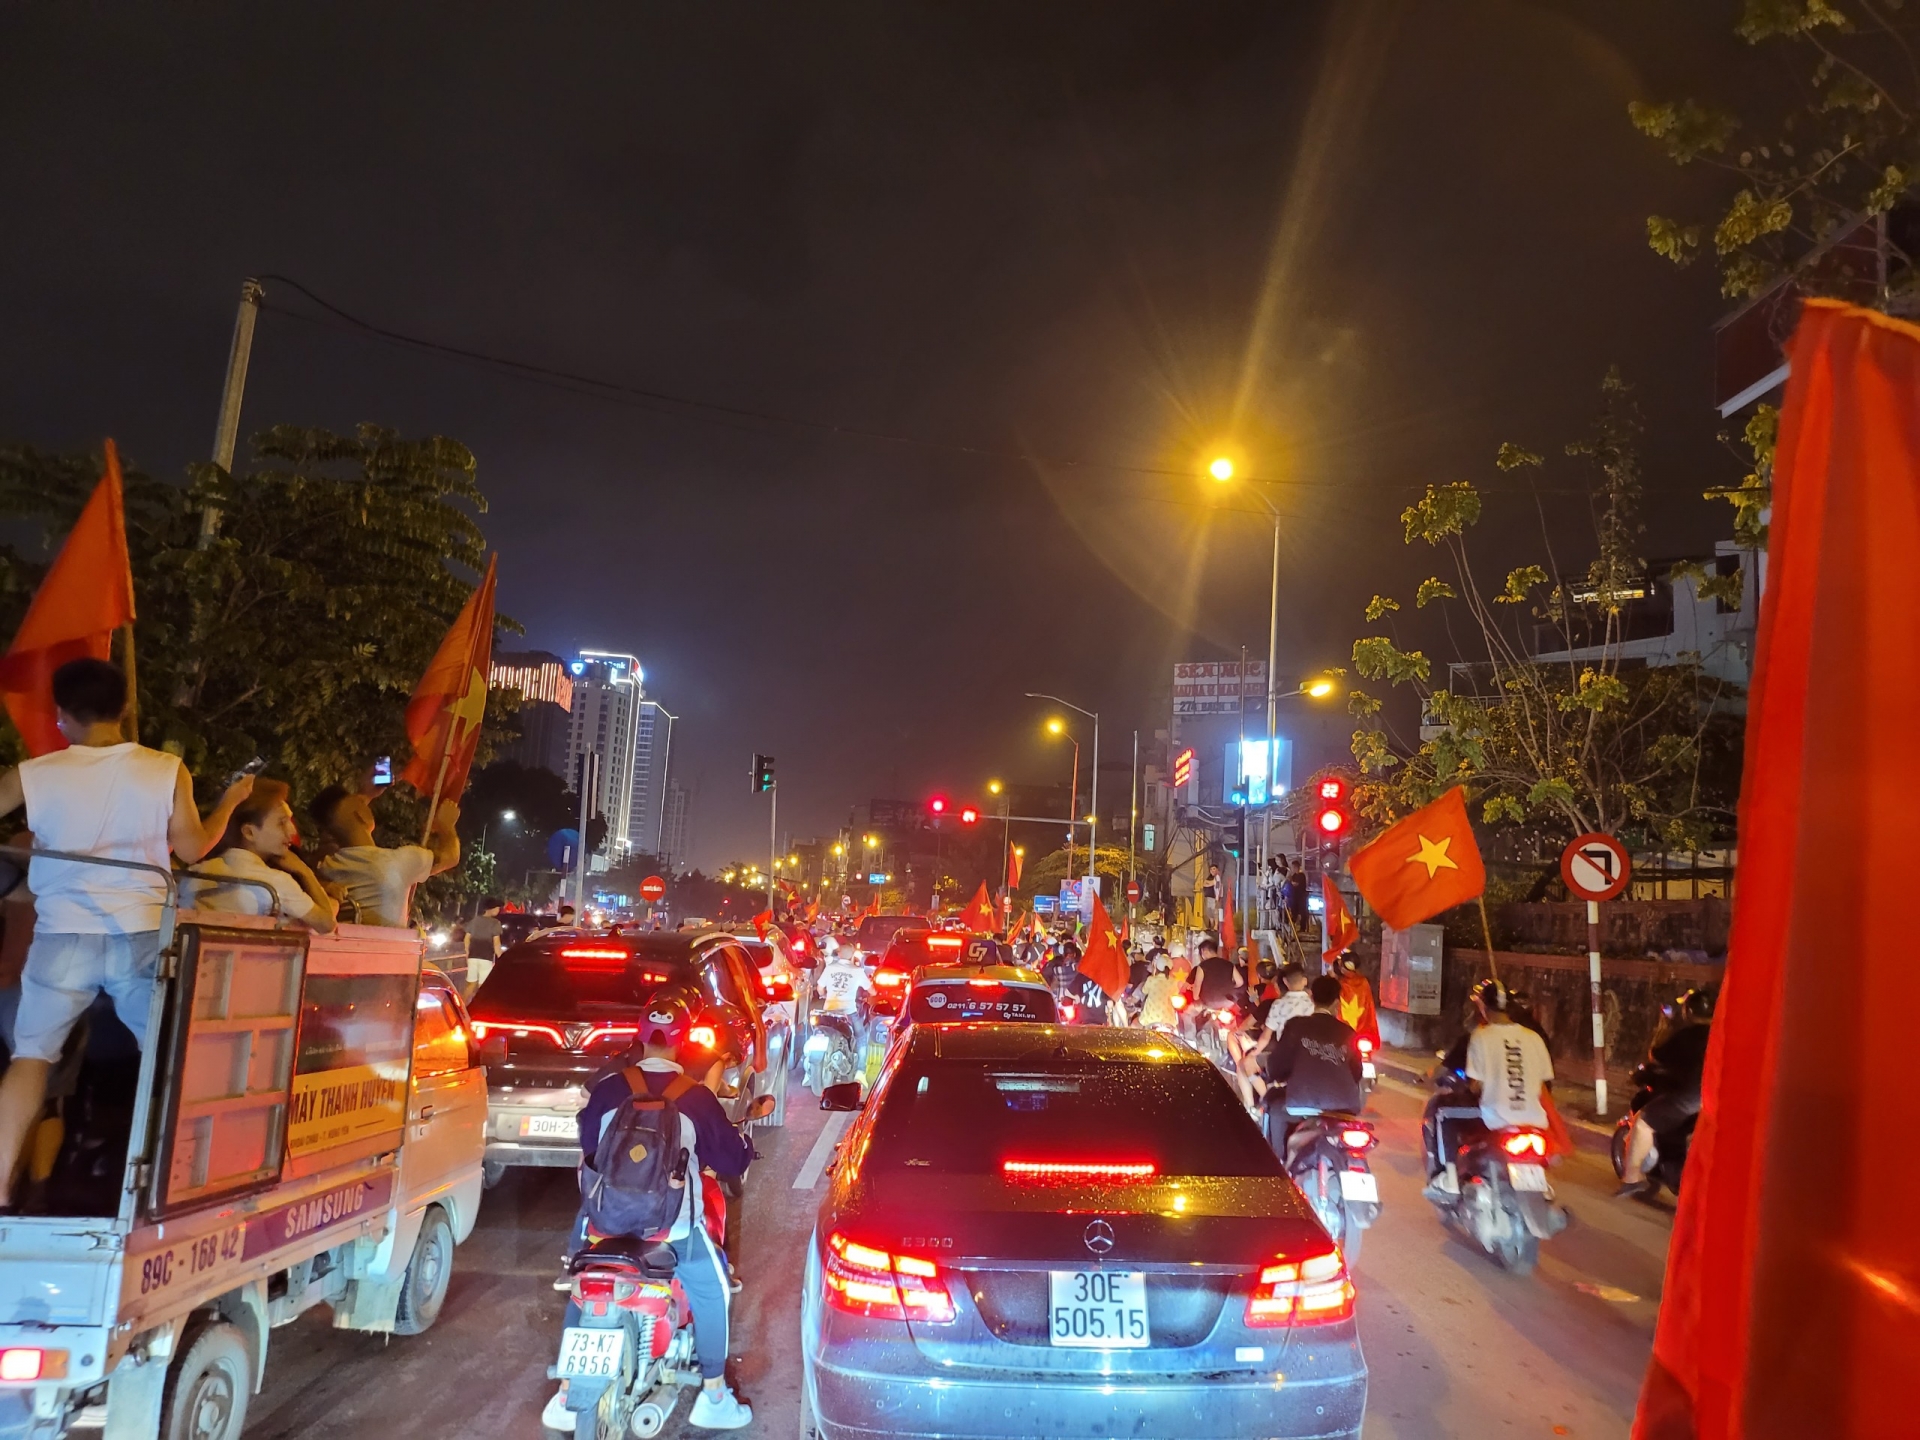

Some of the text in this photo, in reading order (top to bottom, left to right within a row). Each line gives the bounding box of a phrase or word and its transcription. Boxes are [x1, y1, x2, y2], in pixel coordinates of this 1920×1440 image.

[320, 1082, 358, 1119] THANH
[284, 1183, 365, 1239] SAMSUNG
[903, 1237, 953, 1248] E300
[140, 1250, 174, 1294] 89C
[190, 1234, 217, 1275] 168
[220, 1226, 239, 1262] 42
[1074, 1272, 1123, 1303] 30E
[1055, 1307, 1144, 1339] 505.15
[571, 1333, 615, 1353] 73-K7
[566, 1355, 611, 1375] 6956
